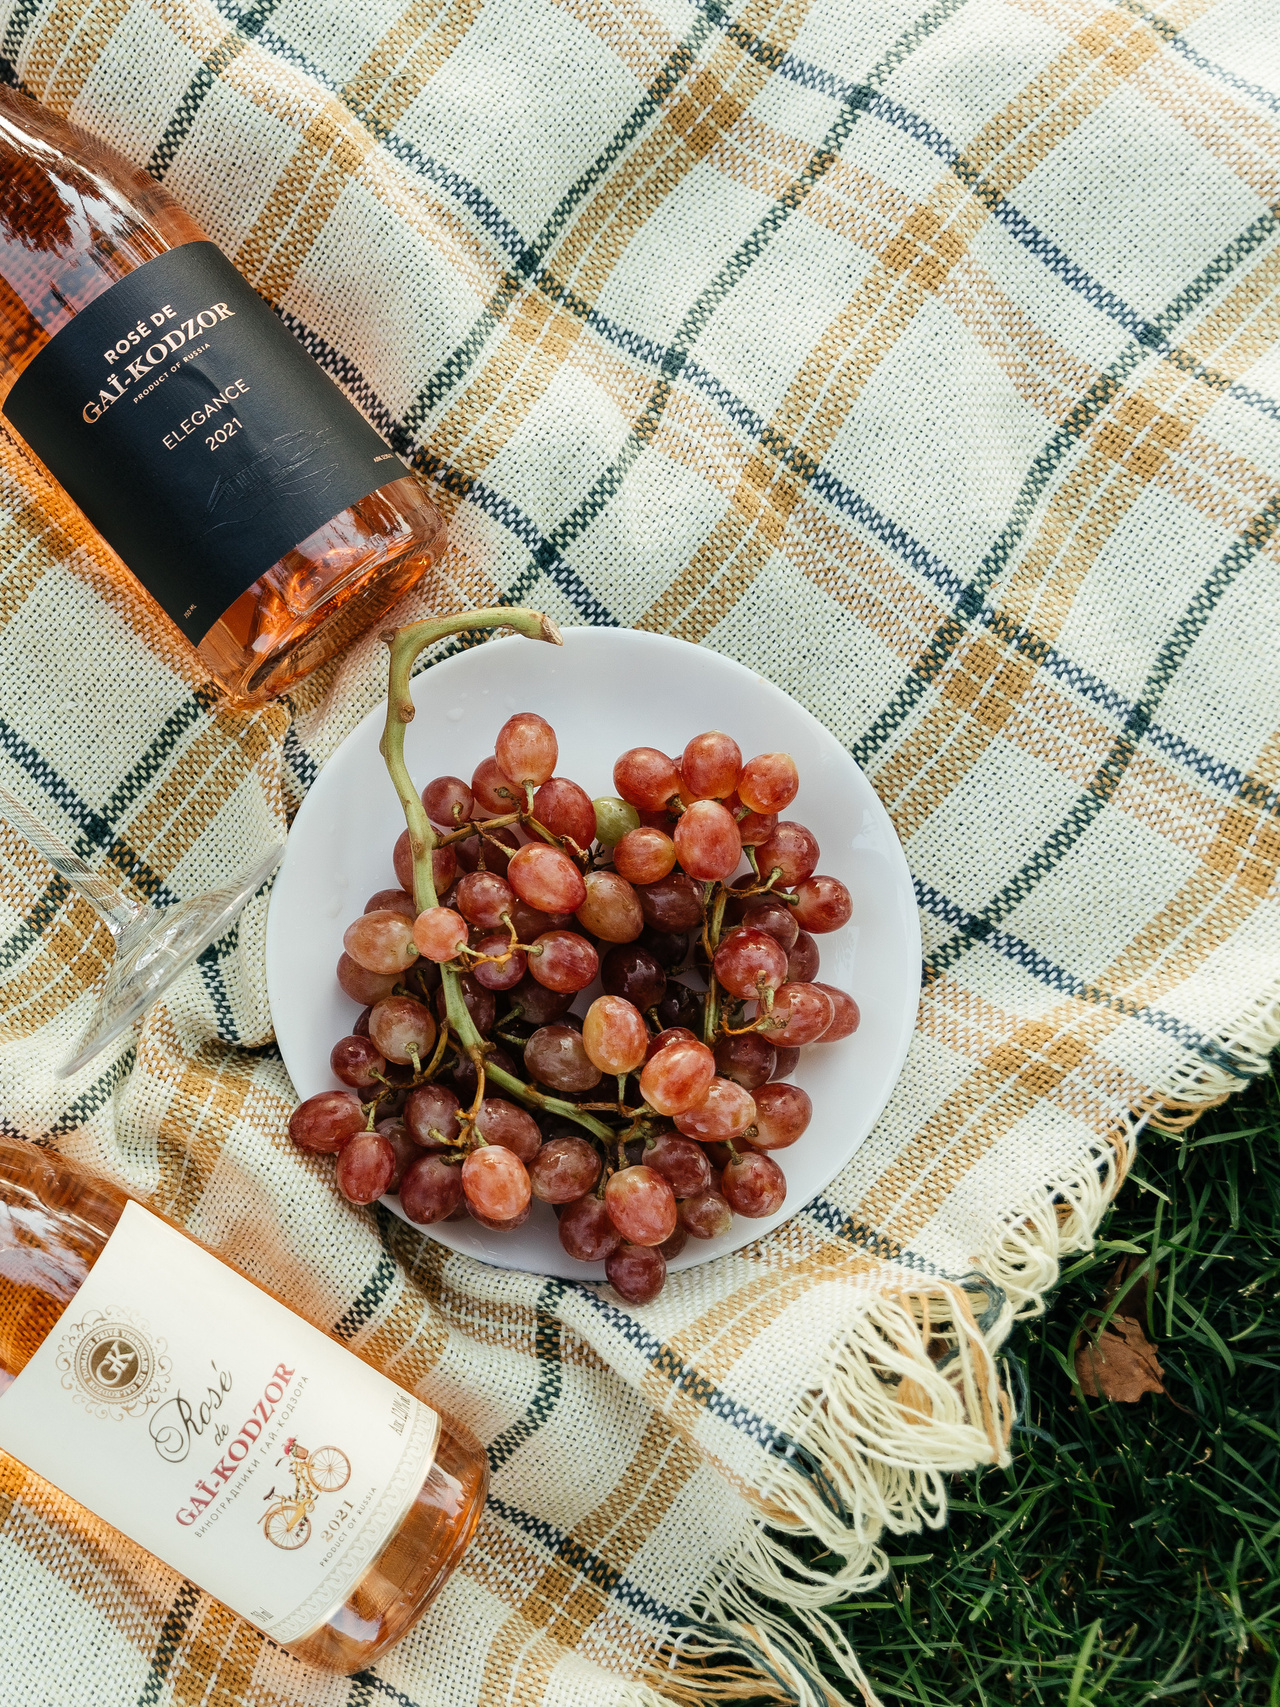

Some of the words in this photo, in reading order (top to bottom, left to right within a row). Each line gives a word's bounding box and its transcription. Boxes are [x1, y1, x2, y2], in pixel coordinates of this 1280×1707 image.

[82, 302, 236, 424] GAÏ-KODZOR
[103, 320, 152, 365] ROSÉ
[150, 304, 178, 327] DE
[133, 372, 170, 404] PRODUCT
[170, 361, 181, 373] OF
[182, 343, 211, 363] RUSSIA
[162, 378, 251, 450] ELEGANCE
[205, 417, 243, 451] 2021
[96, 1340, 136, 1385] GK
[148, 1359, 233, 1463] Rosé
[175, 1362, 295, 1526] GAÏ-KODZOR
[214, 1422, 229, 1446] de
[194, 1458, 260, 1538] ВИНОГРАДНИКИ
[260, 1375, 309, 1455] ГАЙ-КОДЗОРА
[319, 1531, 348, 1568] PRODUCT
[347, 1517, 357, 1529] OF
[357, 1487, 377, 1516] RUSSIA
[320, 1499, 355, 1543] 2021
